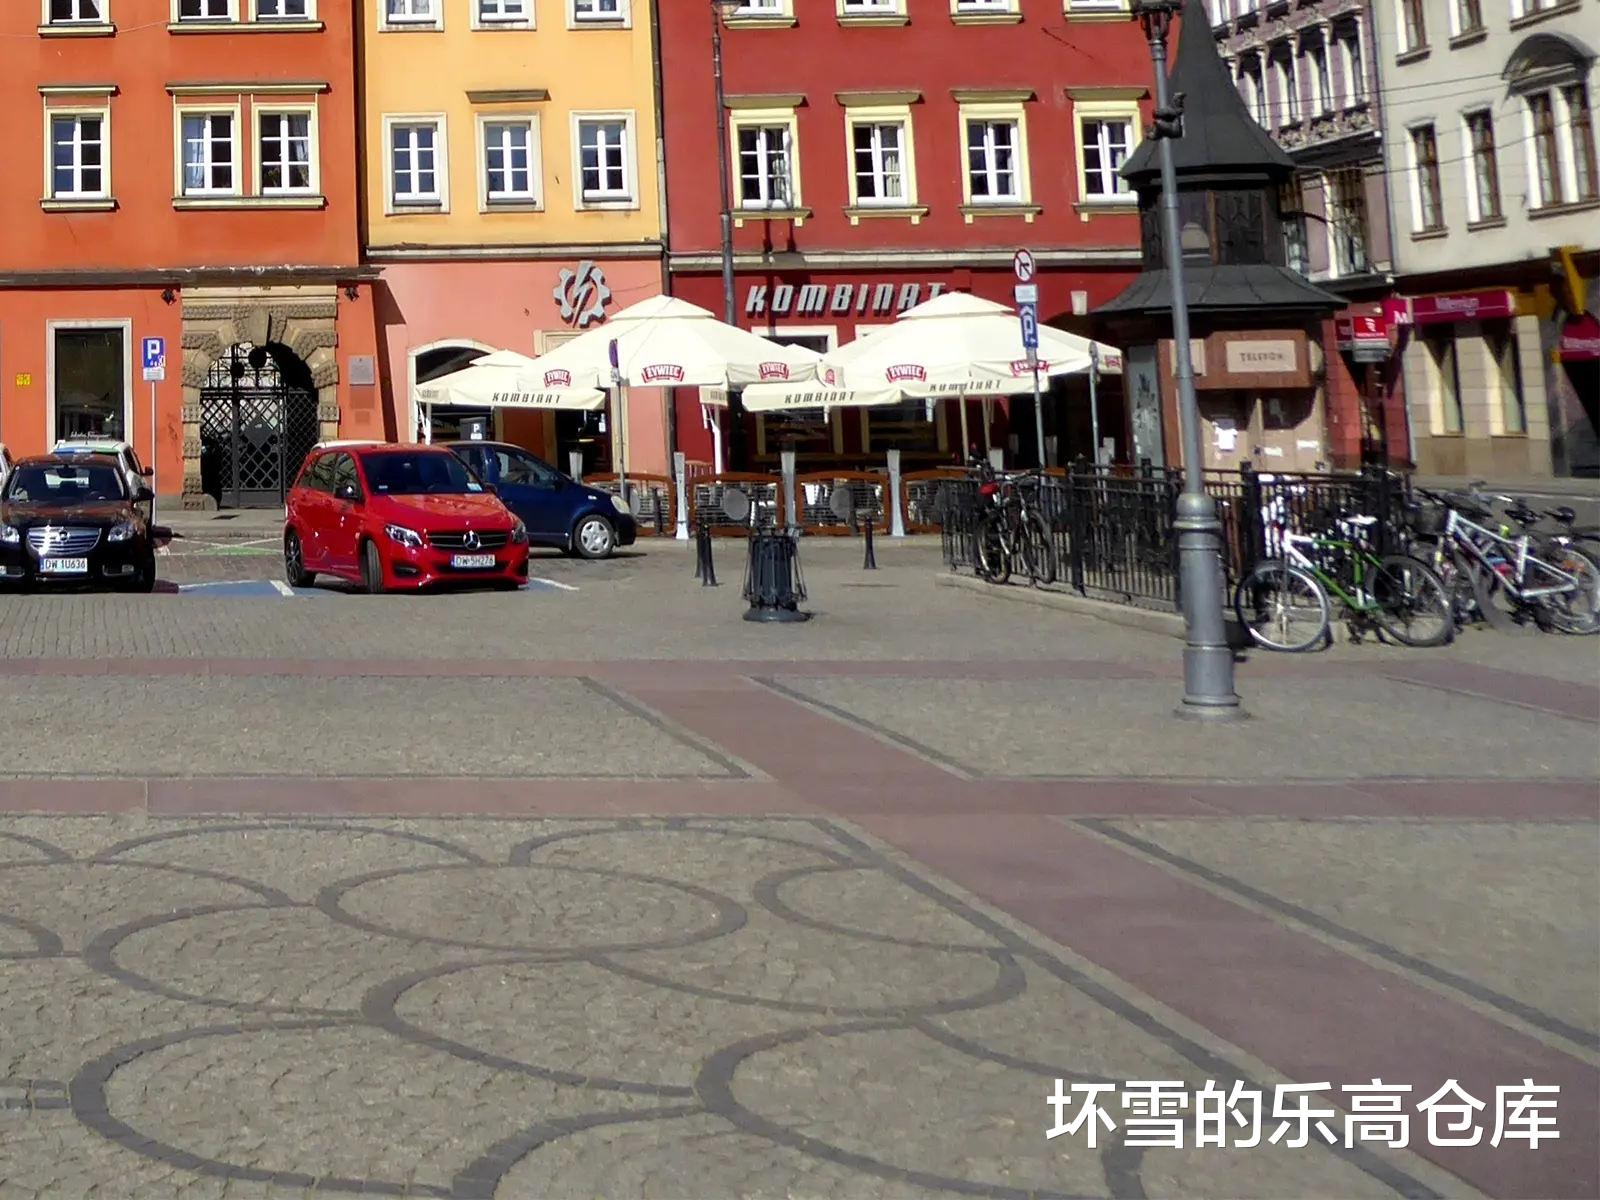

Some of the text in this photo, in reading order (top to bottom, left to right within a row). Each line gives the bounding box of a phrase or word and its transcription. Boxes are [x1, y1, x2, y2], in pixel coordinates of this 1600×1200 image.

[745, 282, 946, 313] KOMBINAT
[147, 339, 161, 359] P
[492, 391, 561, 404] KOMBINAT
[785, 391, 856, 404] KOMBINAT
